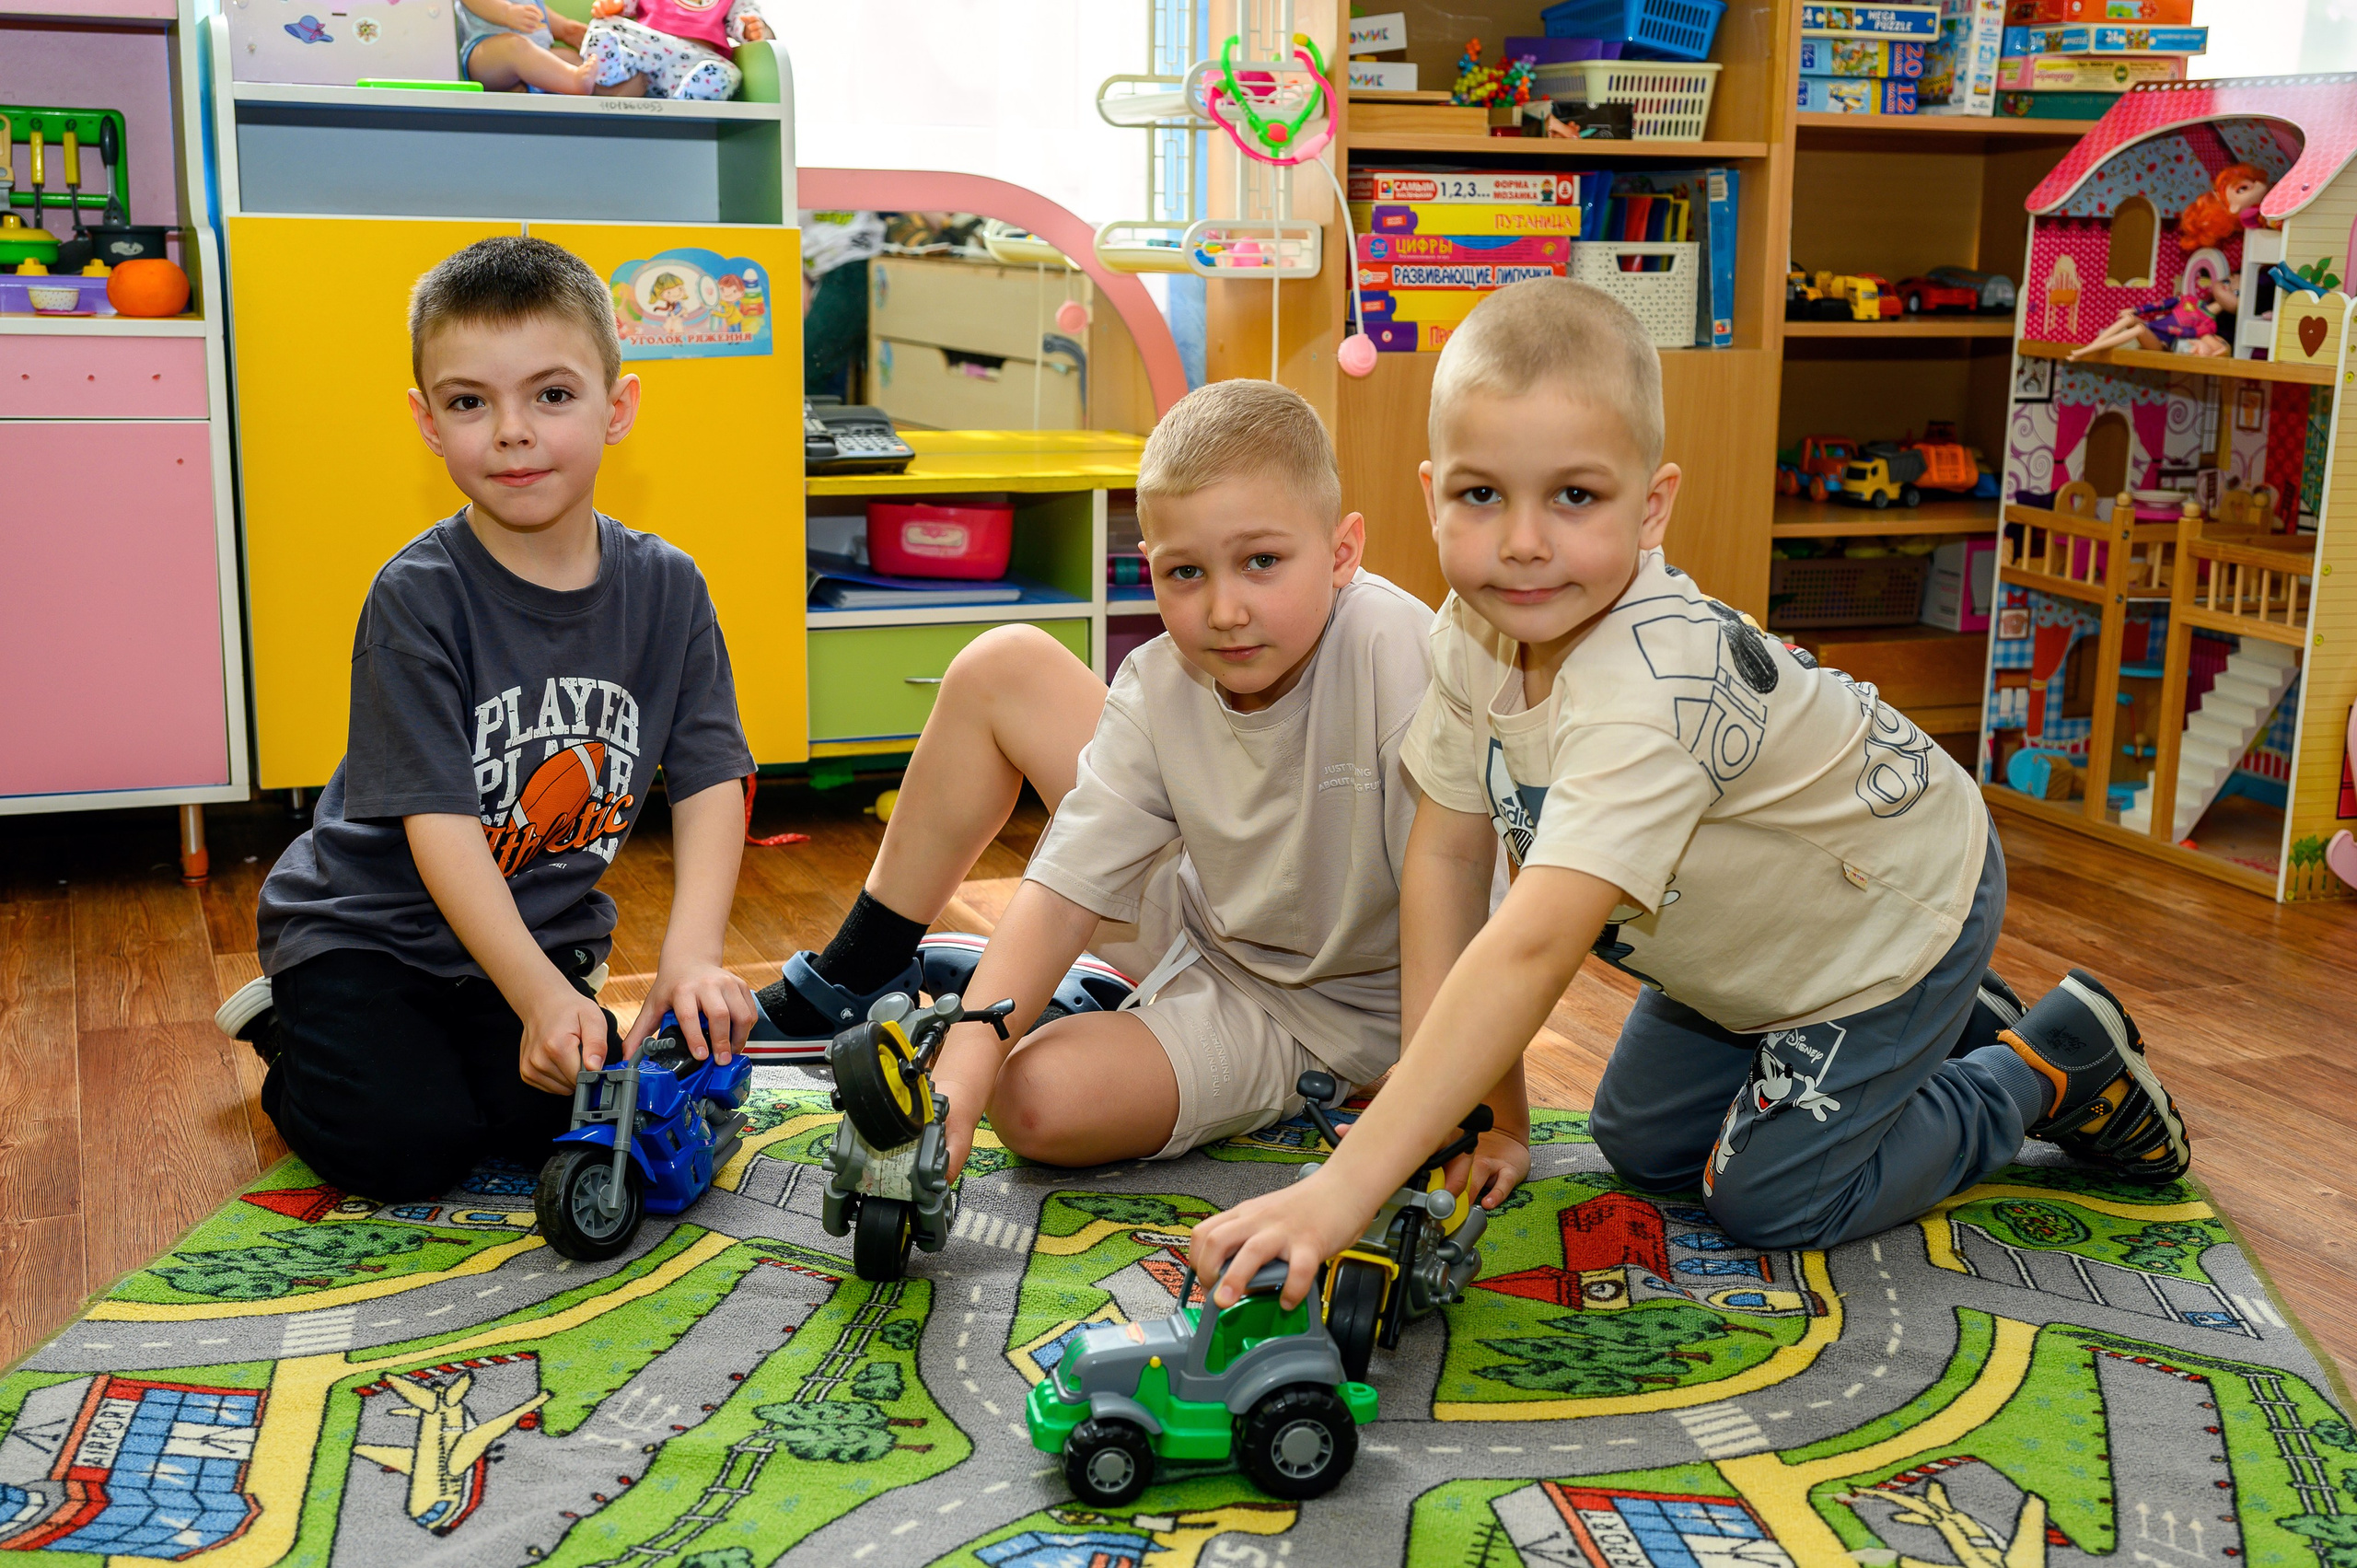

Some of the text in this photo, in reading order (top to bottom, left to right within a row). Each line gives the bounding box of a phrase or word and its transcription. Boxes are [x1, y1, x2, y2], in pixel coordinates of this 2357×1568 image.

[1867, 10, 1897, 21] MEGA
[1874, 19, 1913, 31] PUZZLE
[1349, 28, 1388, 43] ОМИК
[1904, 43, 1925, 78] 20
[1349, 74, 1384, 87] МИК
[1897, 83, 1917, 112] 12
[1394, 181, 1435, 192] САМЫМ
[1493, 180, 1529, 188] ФОРМА
[1494, 214, 1573, 230] ПУТАНИЦА
[1395, 238, 1453, 255] ЦИФРЫ
[1393, 266, 1492, 287] РАЗВИВАЮЩИЕ
[630, 331, 752, 345] УГОЛОК РЯЖЕНИЯ
[472, 677, 641, 764] PLAYER
[1324, 763, 1345, 775] JUST
[1318, 777, 1350, 792] ABOUT
[1212, 1074, 1221, 1098] FUN
[82, 1402, 133, 1466] AIRPORT
[1582, 1512, 1644, 1568] RPORT
